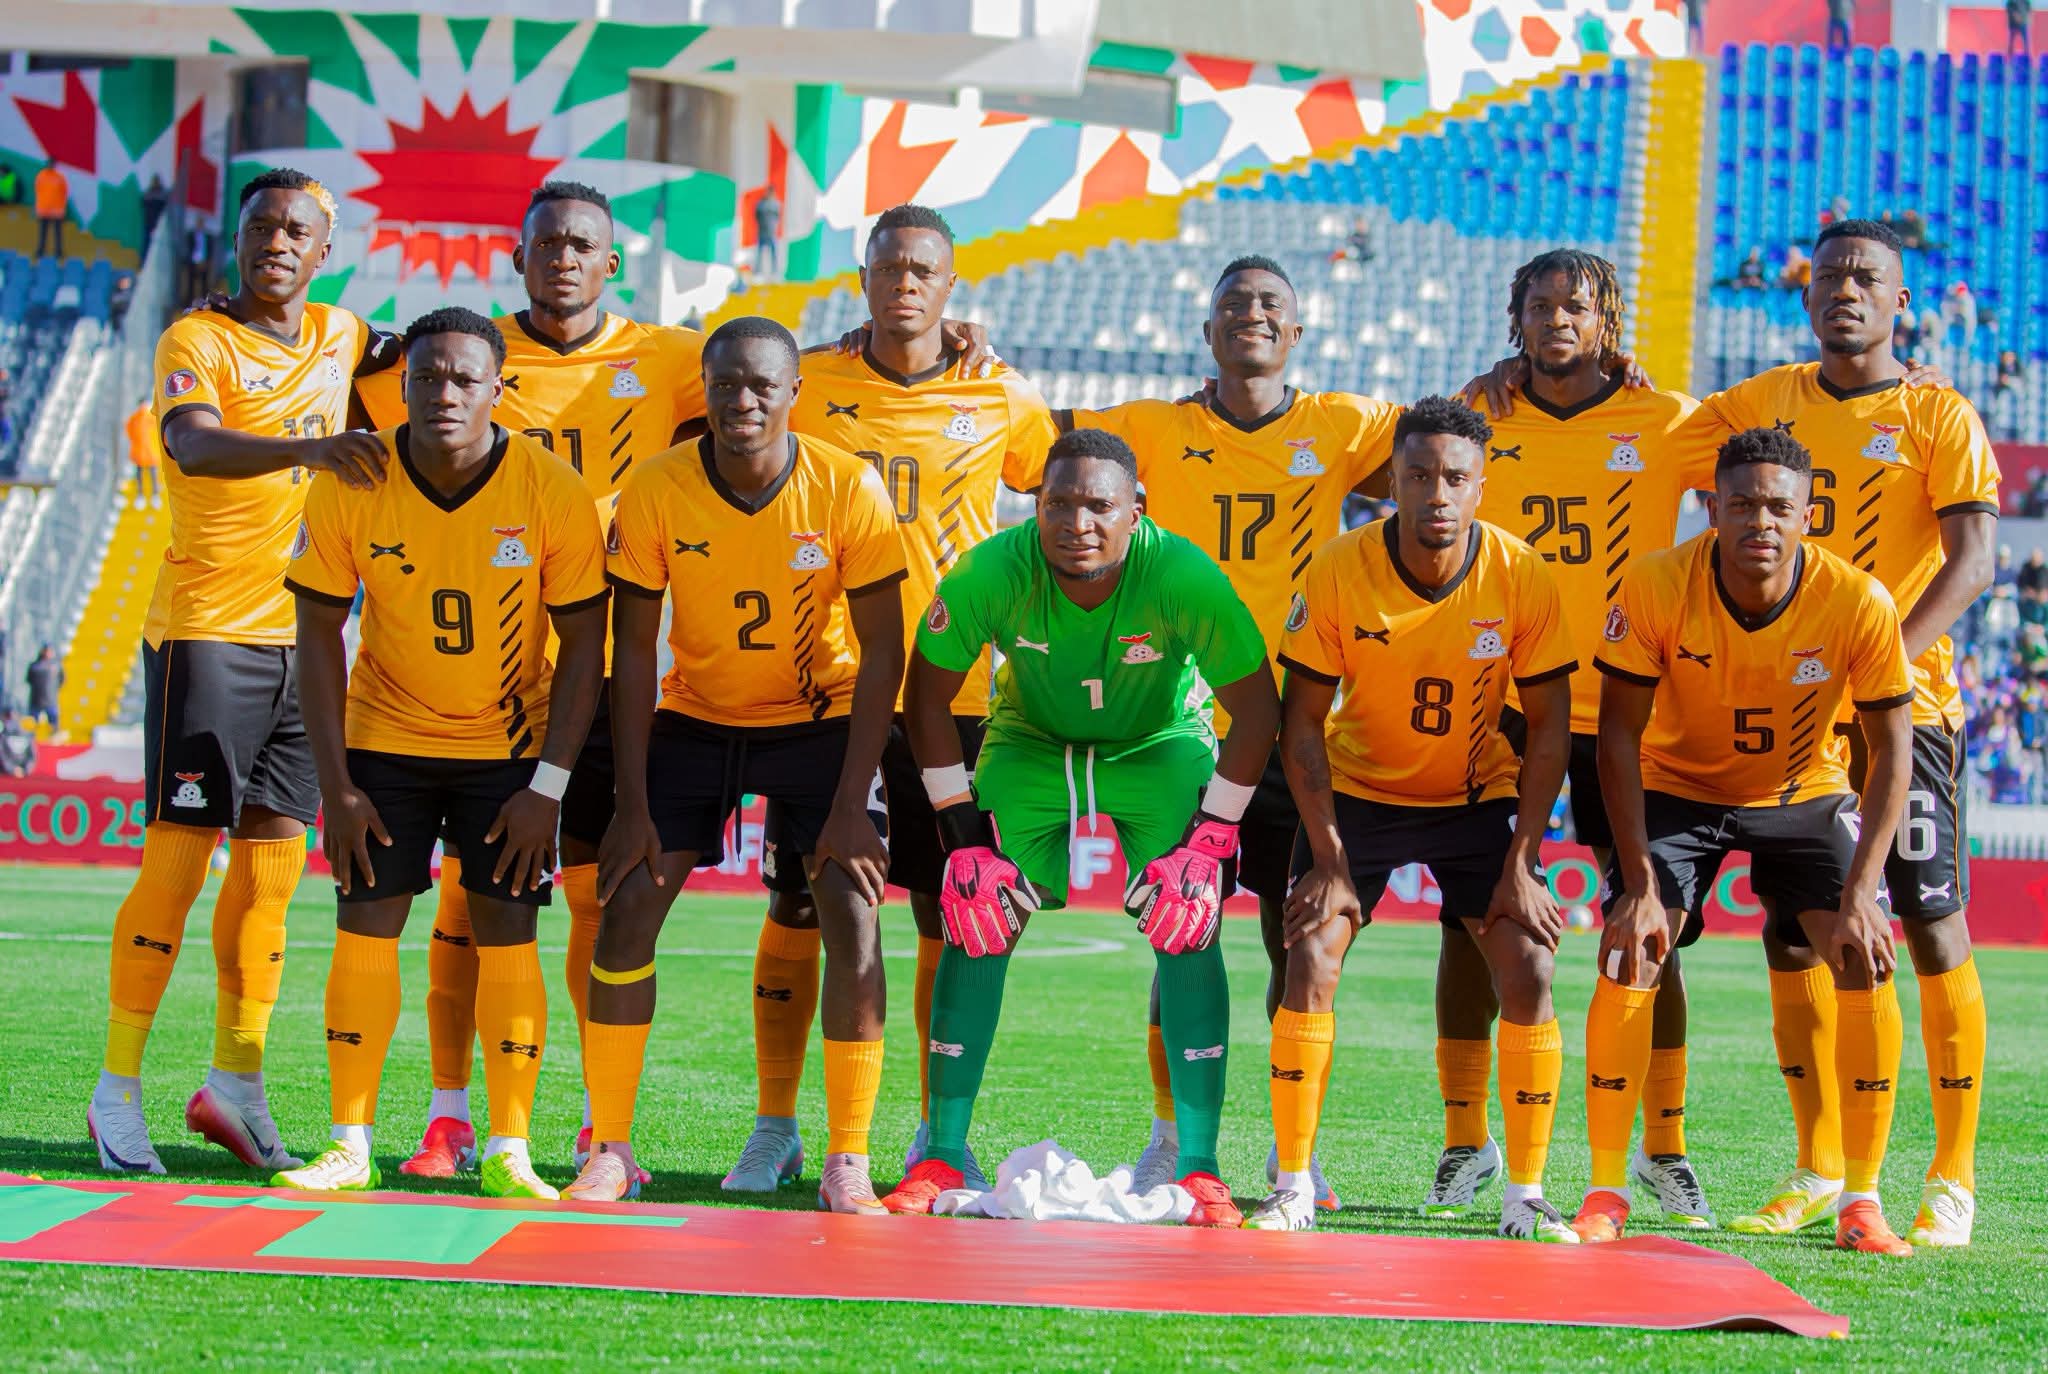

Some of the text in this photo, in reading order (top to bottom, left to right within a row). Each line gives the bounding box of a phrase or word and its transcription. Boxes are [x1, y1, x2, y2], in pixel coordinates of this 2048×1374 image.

[1213, 493, 1275, 561] 17
[1521, 494, 1592, 565] 25
[432, 588, 475, 655] 9
[733, 589, 776, 651] 2
[1080, 678, 1104, 711] 1
[1410, 676, 1455, 737] 8
[1733, 707, 1775, 755] 5
